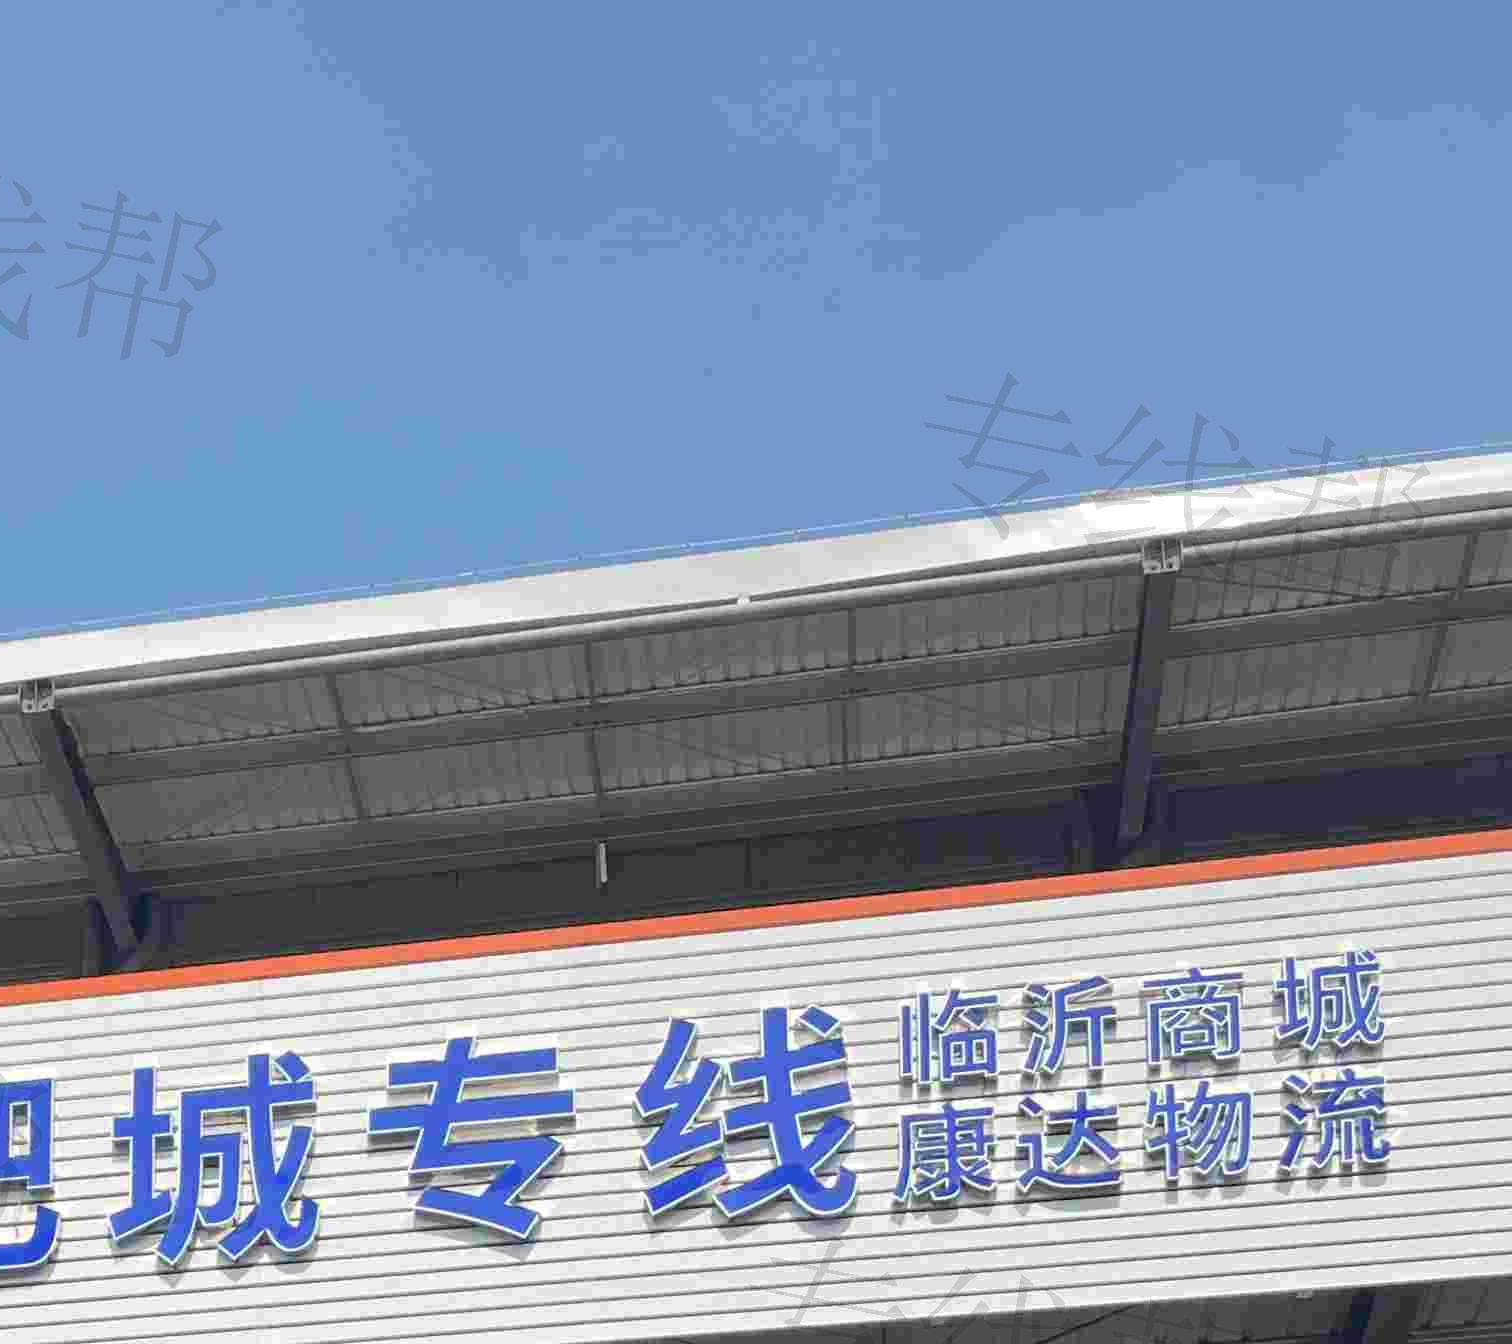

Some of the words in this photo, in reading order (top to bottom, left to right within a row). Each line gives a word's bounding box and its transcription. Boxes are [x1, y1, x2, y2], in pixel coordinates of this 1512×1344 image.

[899, 948, 1388, 1084] 临沂商城
[893, 1068, 1392, 1204] 康达物流
